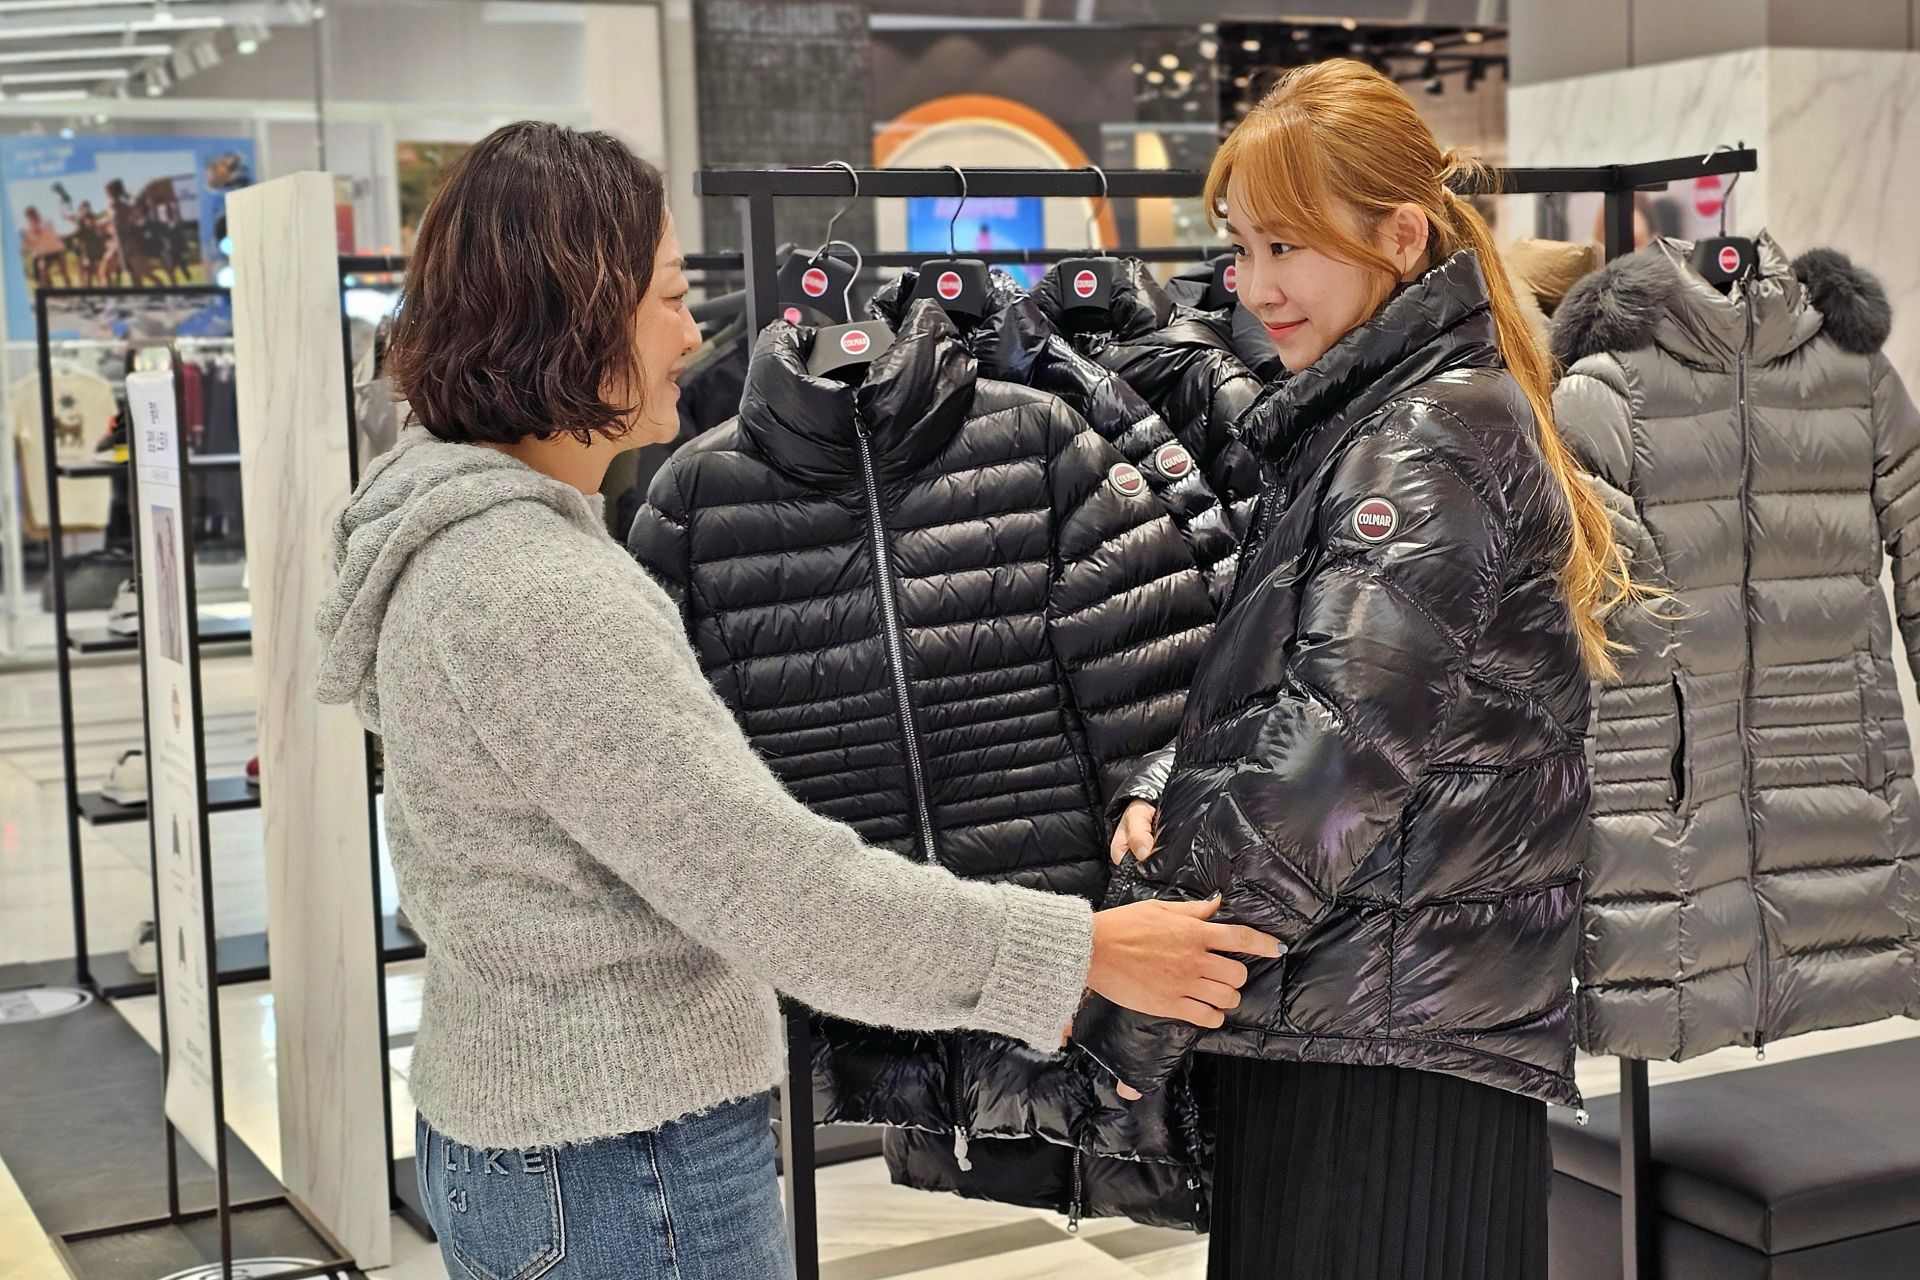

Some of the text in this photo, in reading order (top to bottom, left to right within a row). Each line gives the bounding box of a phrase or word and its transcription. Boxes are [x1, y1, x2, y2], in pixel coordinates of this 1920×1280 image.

[1162, 452, 1187, 470] COLMAR
[1358, 513, 1392, 528] COLMAR
[446, 1143, 546, 1175] LIKE
